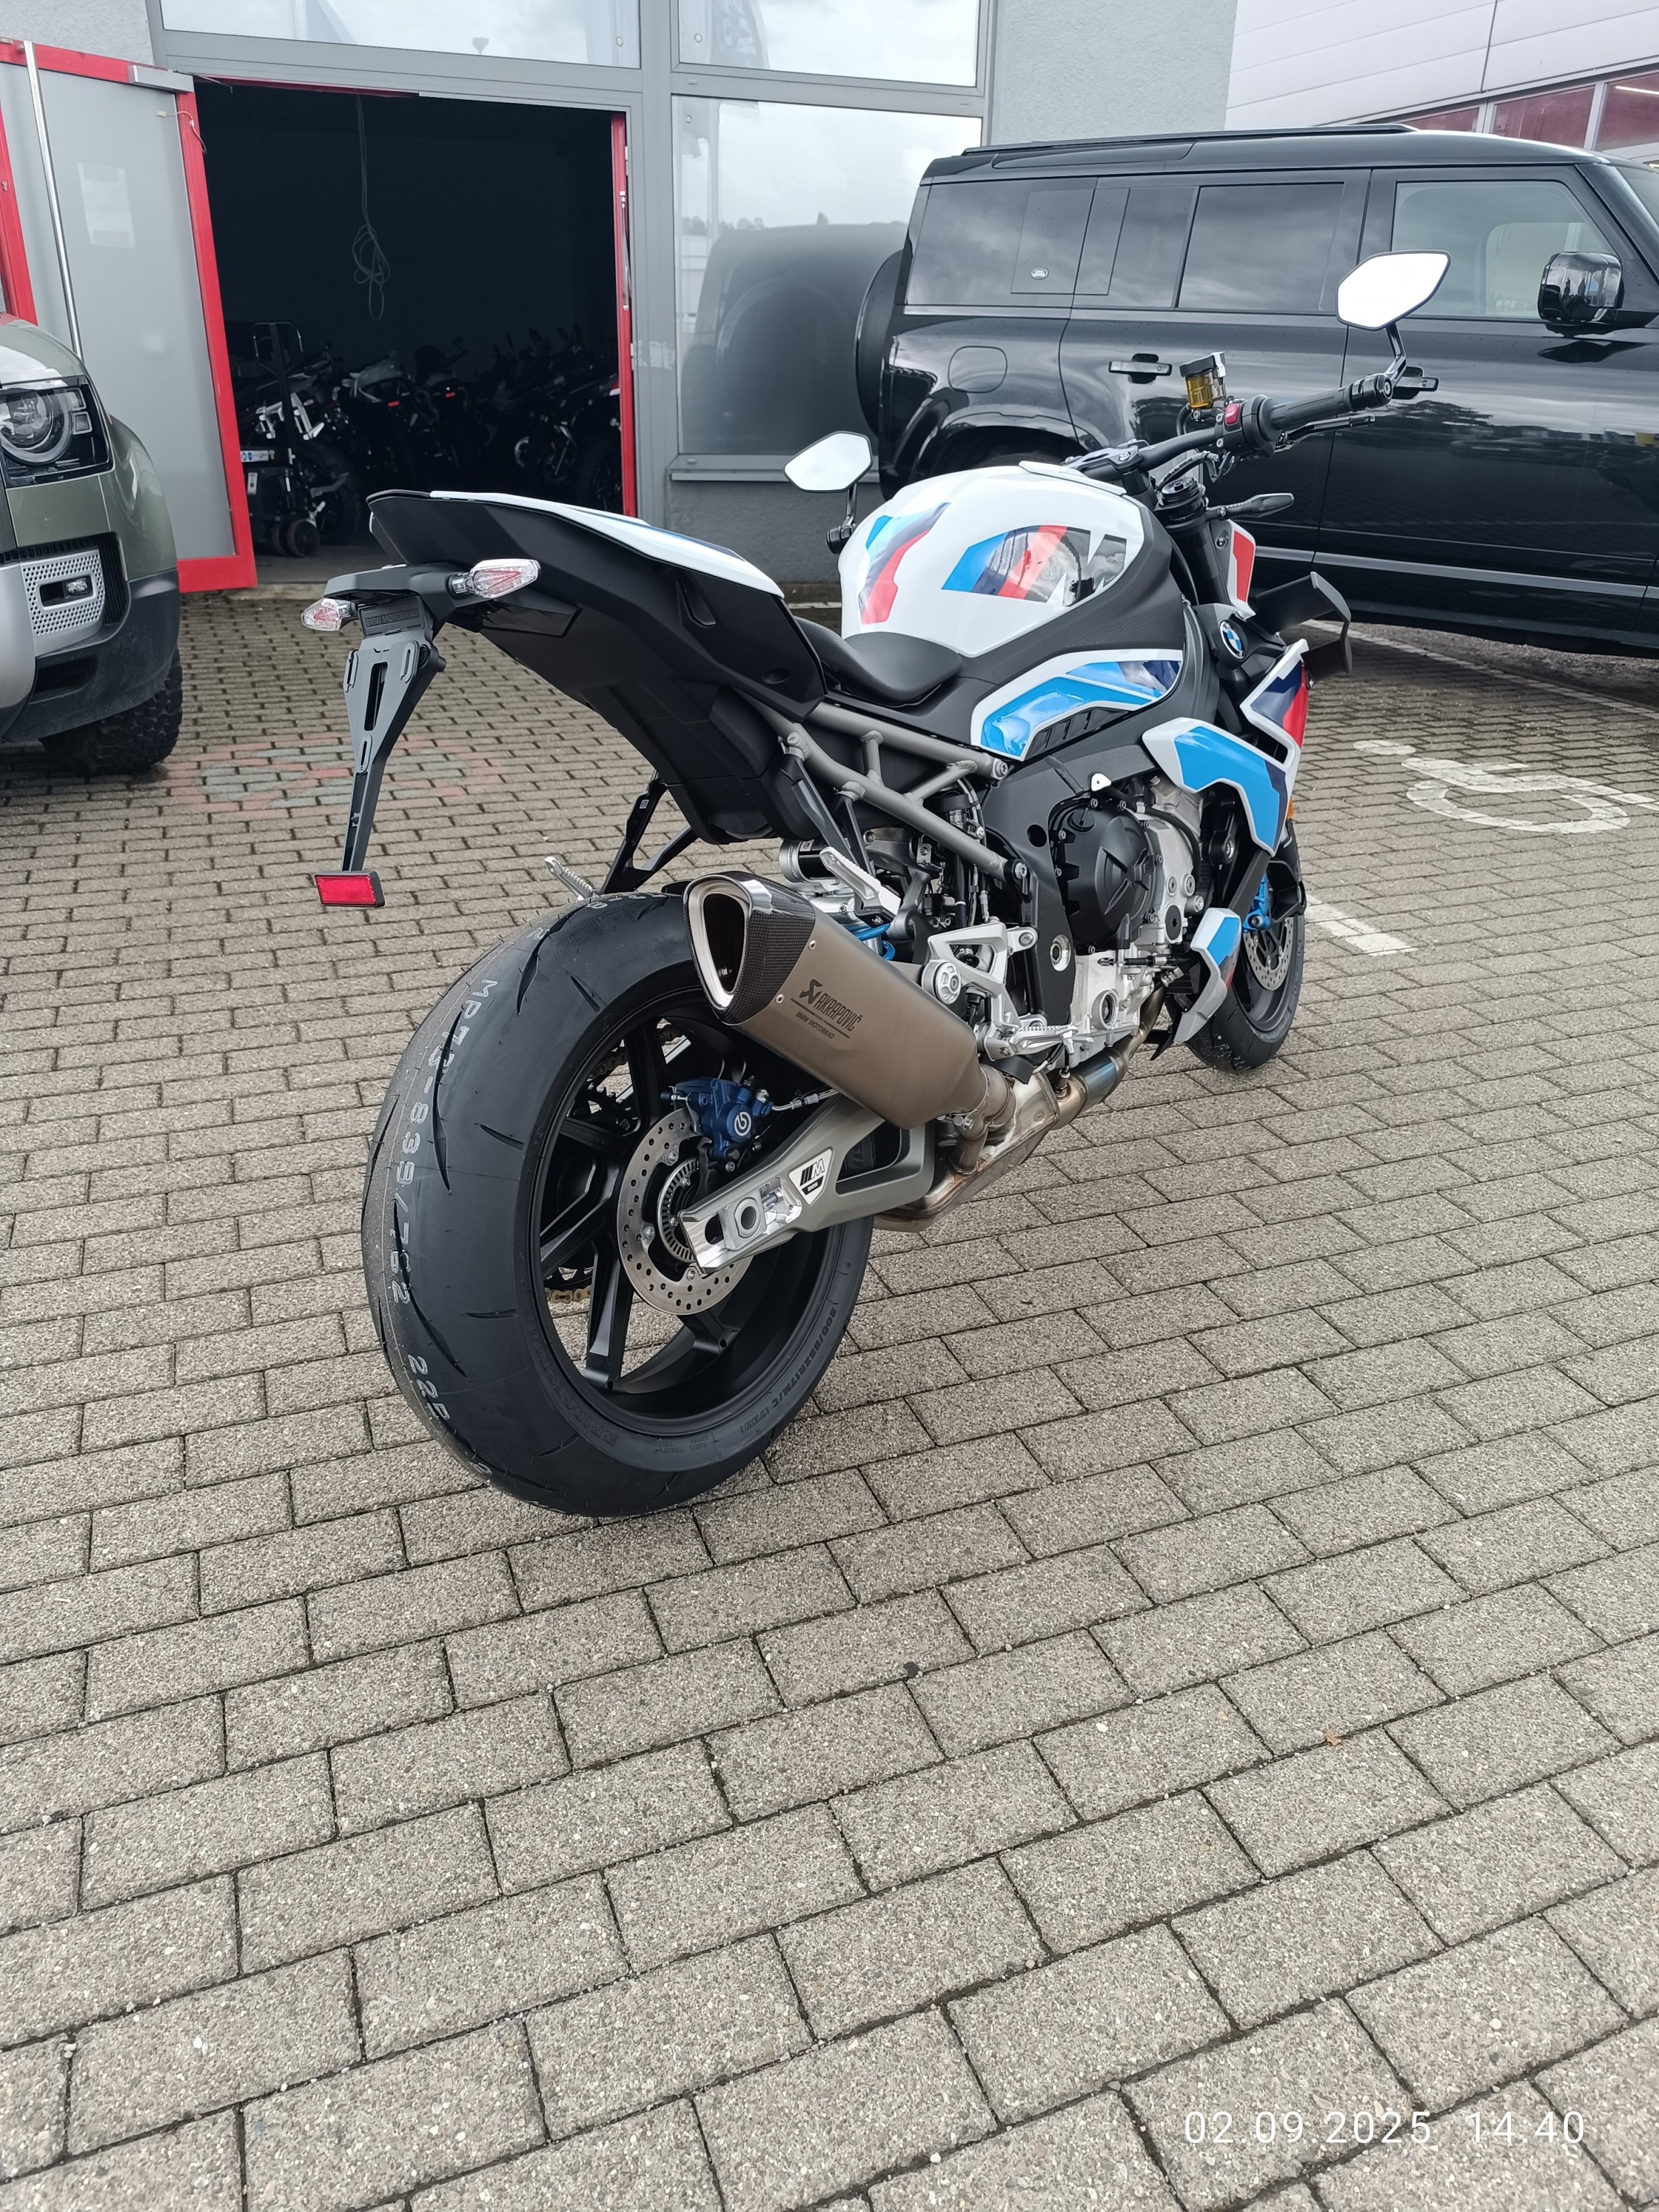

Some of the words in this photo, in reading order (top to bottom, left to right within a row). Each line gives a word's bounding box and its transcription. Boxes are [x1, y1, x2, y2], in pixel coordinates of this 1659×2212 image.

[366, 617, 381, 627] BMW
[382, 610, 418, 623] MOTORRAD
[795, 1011, 810, 1023] BMW
[808, 1019, 835, 1039] MOTORRAD
